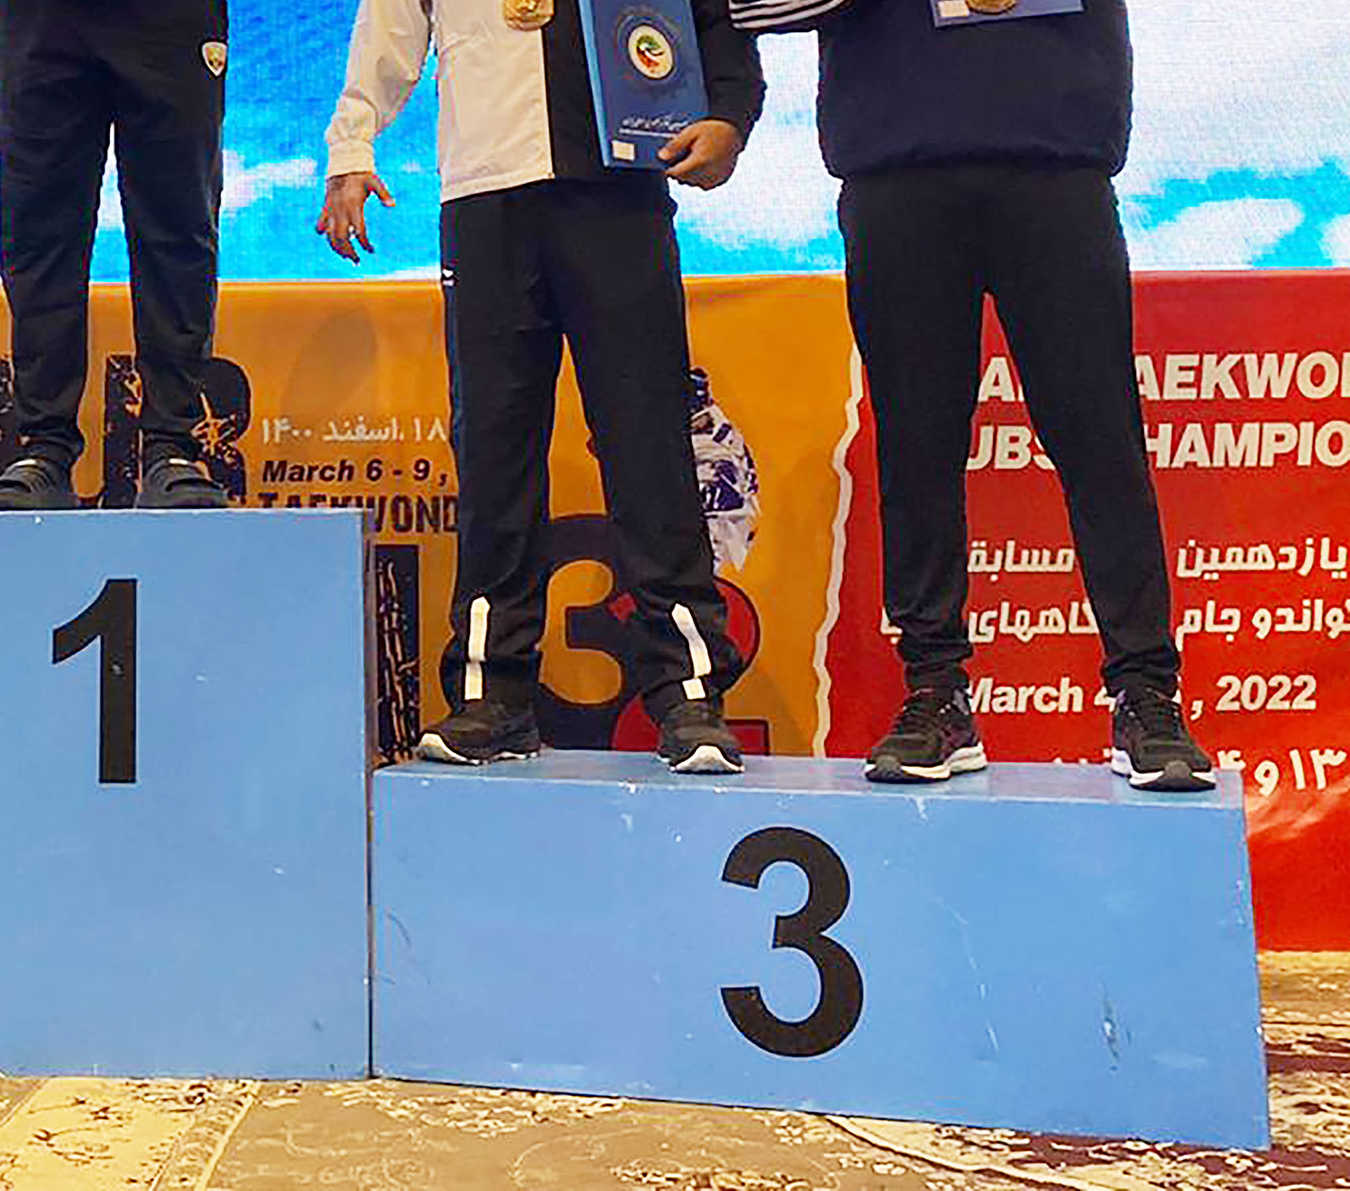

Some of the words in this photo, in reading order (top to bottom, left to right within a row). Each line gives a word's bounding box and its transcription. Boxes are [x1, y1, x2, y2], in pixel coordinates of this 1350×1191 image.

[1135, 351, 1350, 401] AEKWO
[262, 460, 354, 483] March
[366, 458, 383, 482] 6
[1175, 537, 1348, 581] یازدهمین
[1175, 600, 1241, 652] جام
[1252, 597, 1350, 640] واندو
[52, 578, 138, 783] 1
[1215, 674, 1317, 712] 2022
[719, 825, 864, 1058] 3
